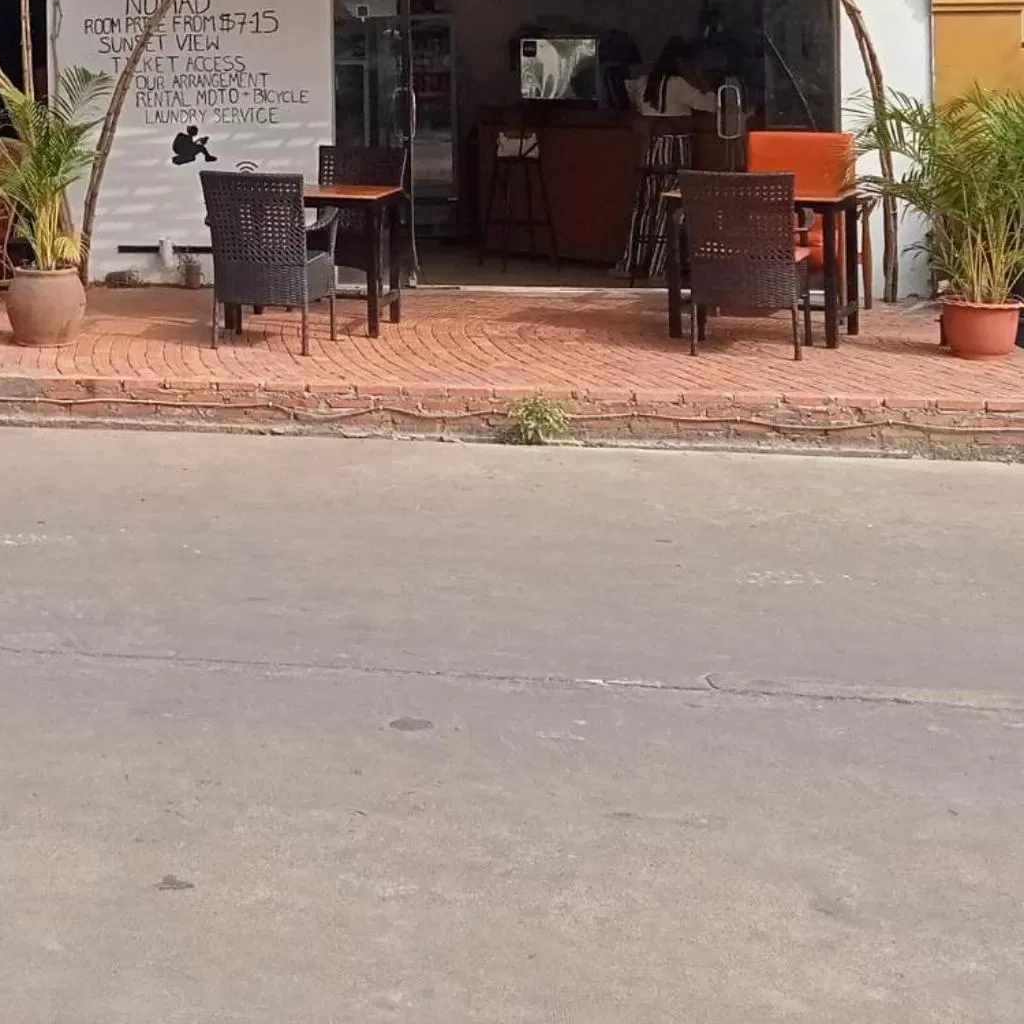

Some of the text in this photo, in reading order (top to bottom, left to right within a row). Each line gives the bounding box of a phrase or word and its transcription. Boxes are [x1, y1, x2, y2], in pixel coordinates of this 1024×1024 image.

[84, 17, 121, 34] ROOM
[125, 16, 166, 33] PRE
[172, 14, 216, 33] FROM
[176, 33, 219, 52] VIEW
[111, 55, 247, 73] TKET ACCESS
[134, 72, 272, 91] OUR ARRANGEMENT
[136, 88, 191, 108] RENTAL
[196, 88, 239, 107] MOTO
[253, 88, 310, 104] BICYCLE
[145, 107, 280, 125] LAUNDRY SERVICE
